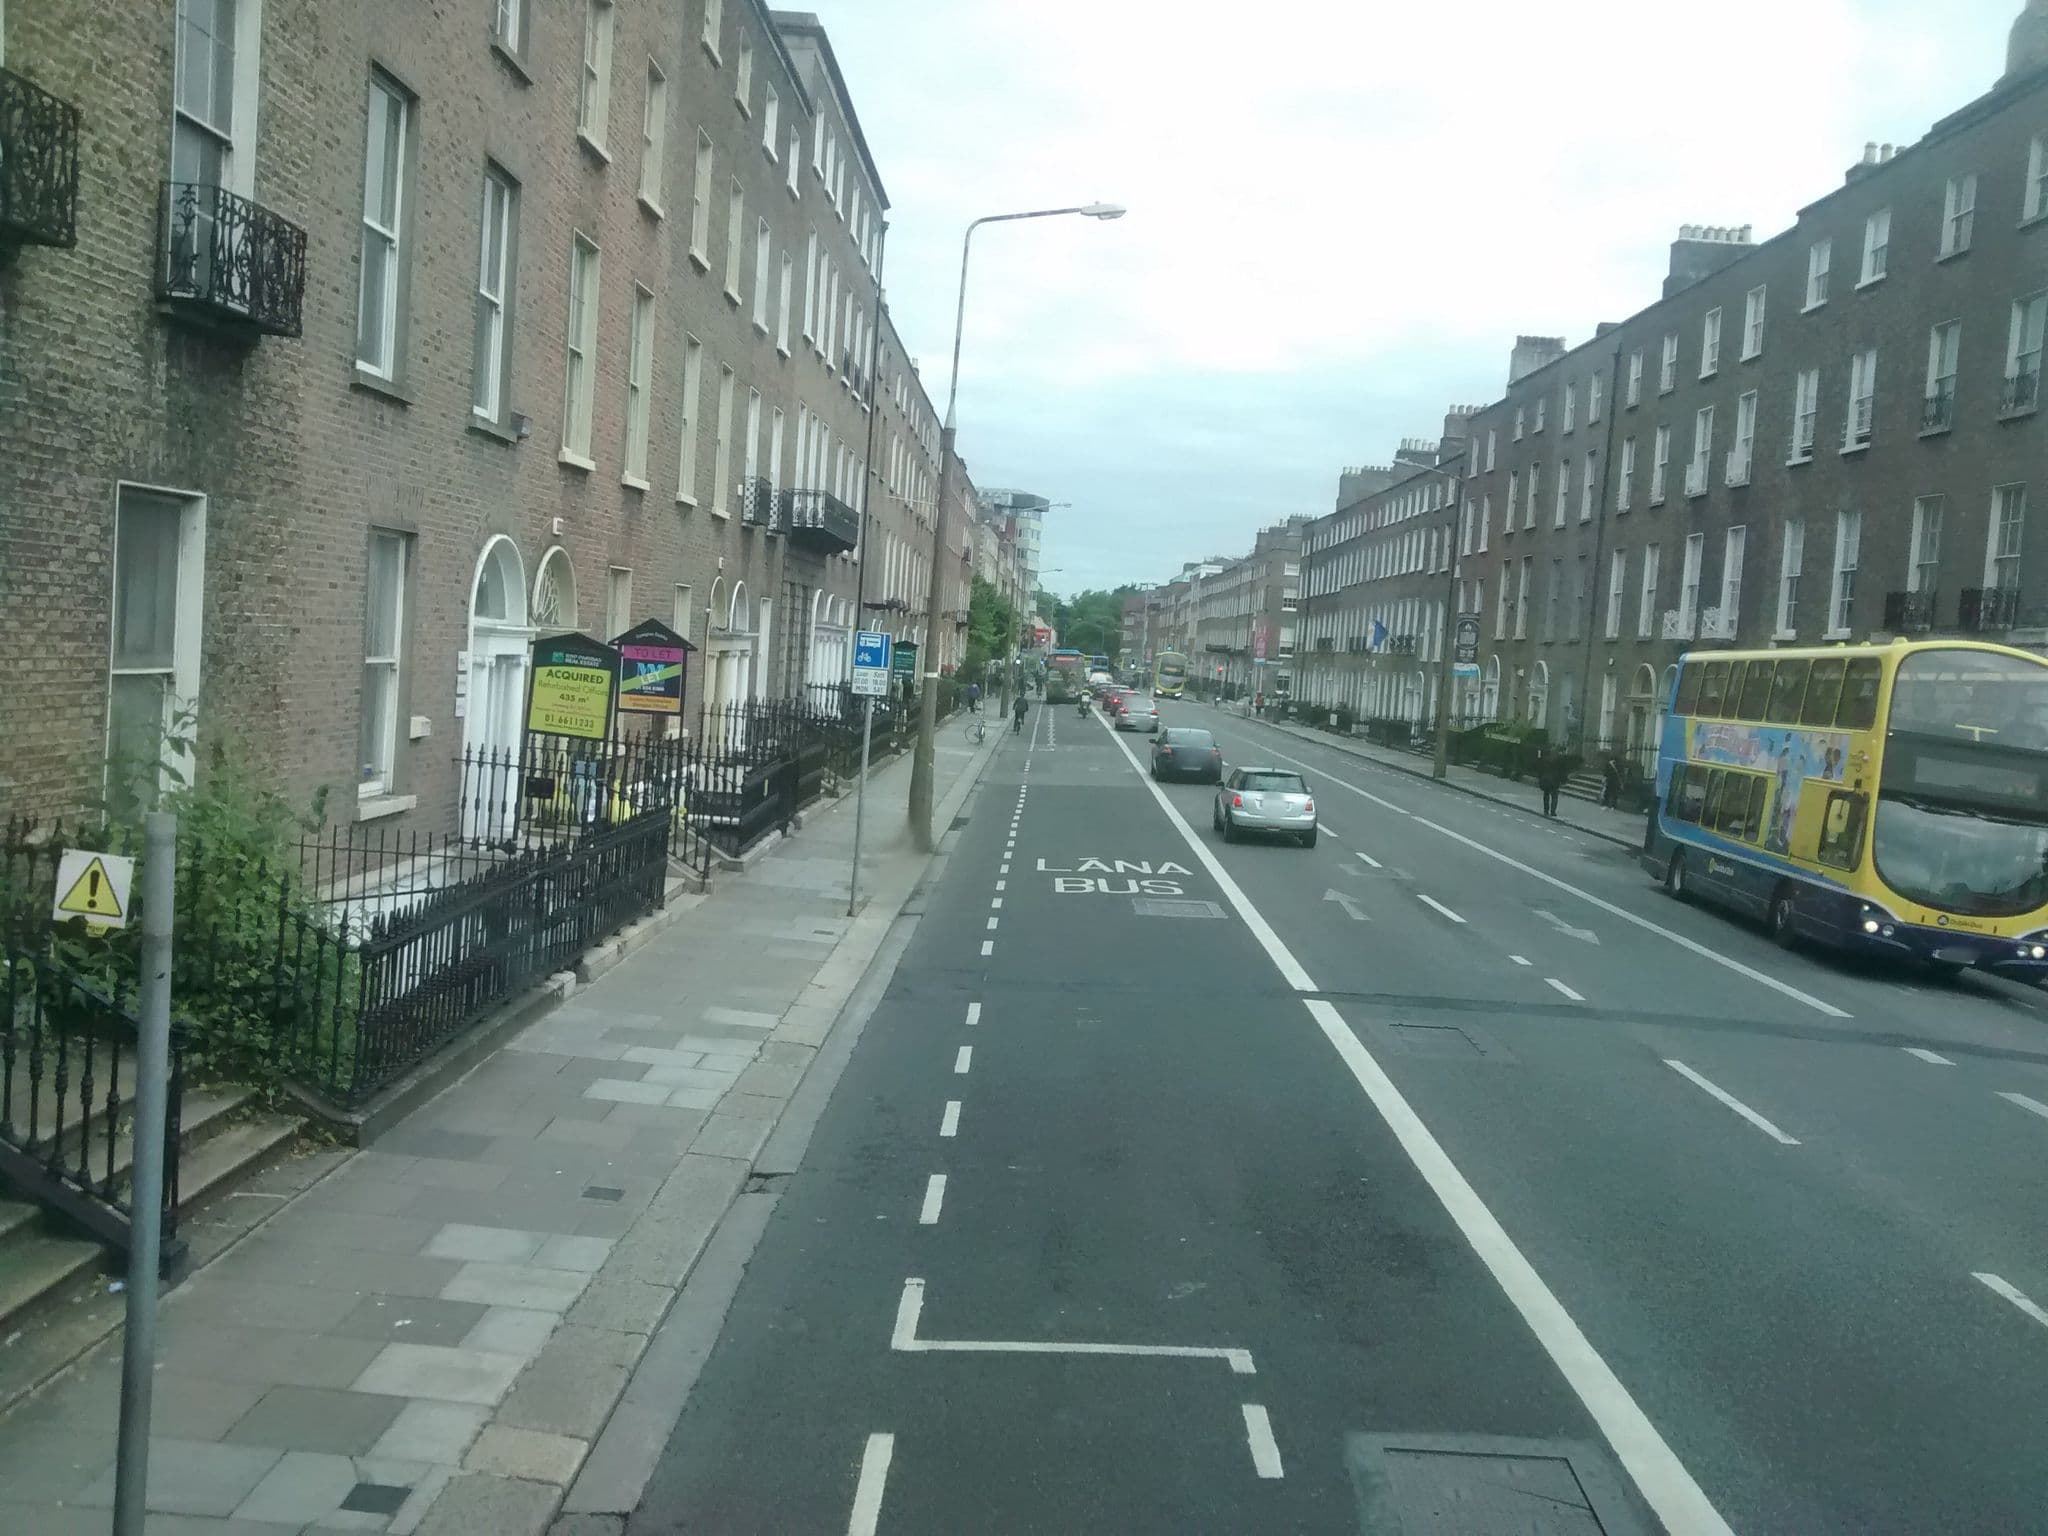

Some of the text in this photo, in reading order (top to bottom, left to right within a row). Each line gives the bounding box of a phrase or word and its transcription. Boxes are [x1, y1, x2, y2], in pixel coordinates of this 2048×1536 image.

[634, 647, 672, 659] TO LET
[546, 668, 604, 684] ACQUIRED
[640, 673, 661, 685] LET
[538, 679, 581, 693] Refurbished
[560, 693, 576, 702] 435
[544, 714, 554, 722] 01
[1054, 877, 1184, 895] BUS
